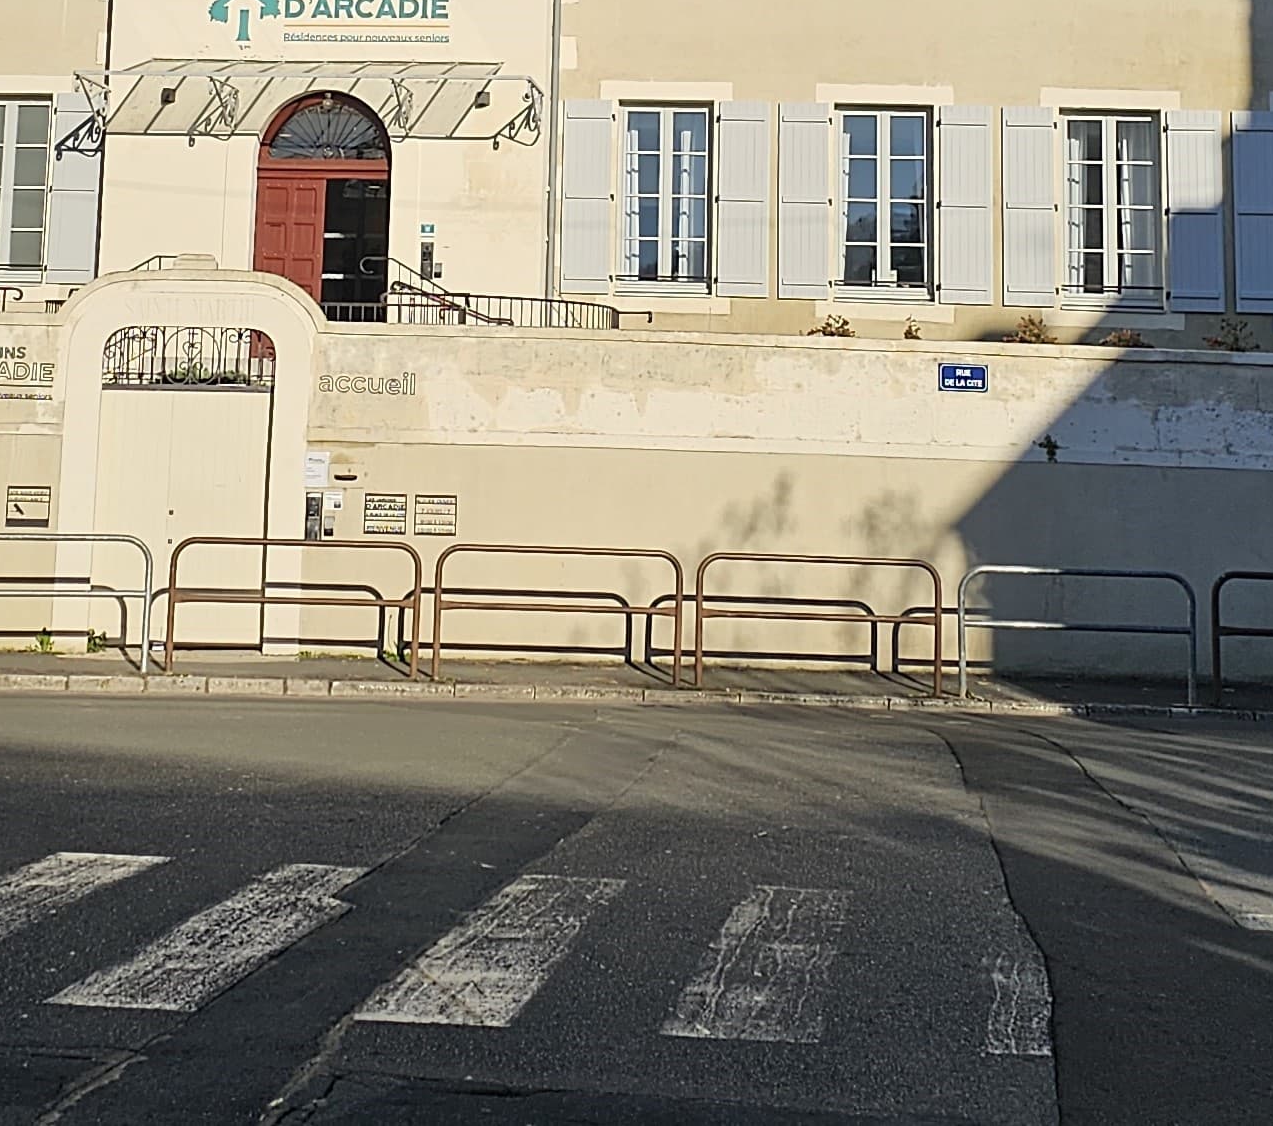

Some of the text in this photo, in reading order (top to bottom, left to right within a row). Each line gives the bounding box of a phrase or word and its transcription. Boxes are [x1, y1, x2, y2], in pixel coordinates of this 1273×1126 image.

[955, 368, 972, 377] RUE
[318, 371, 416, 396] accueil
[955, 378, 966, 387] LA
